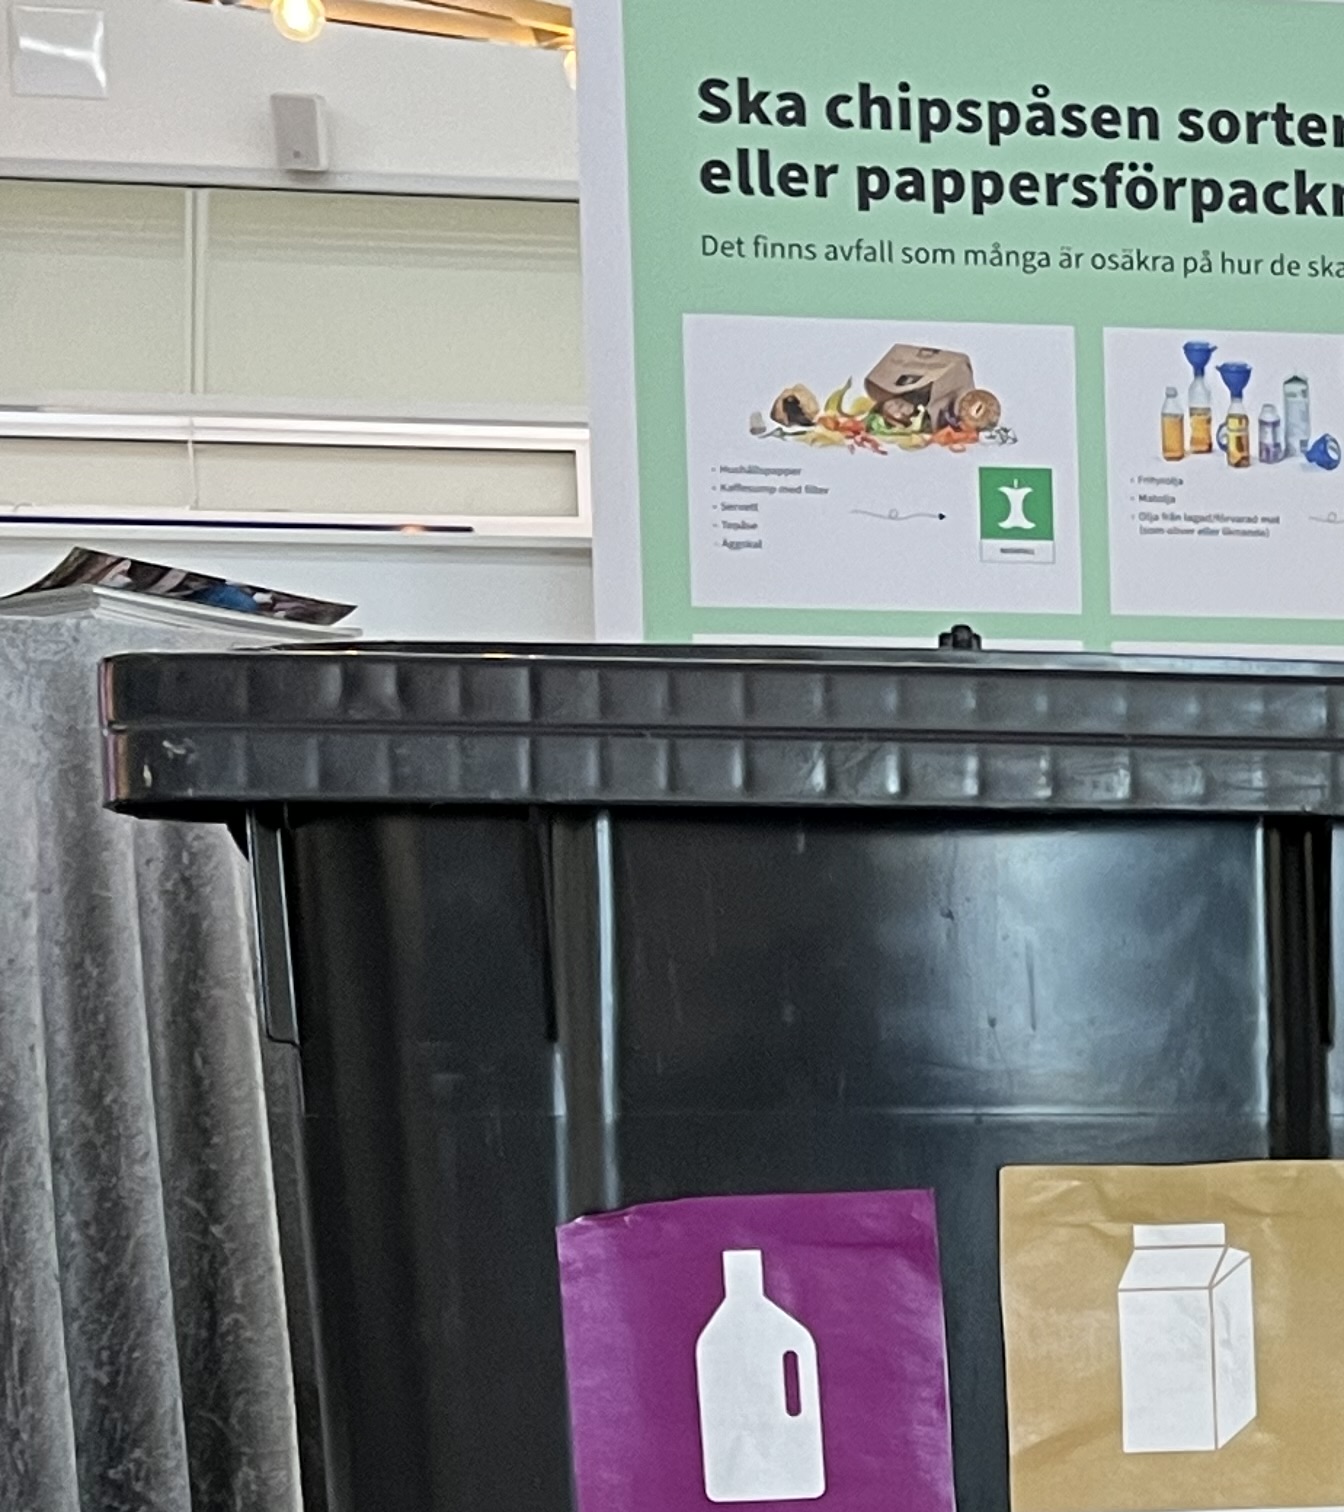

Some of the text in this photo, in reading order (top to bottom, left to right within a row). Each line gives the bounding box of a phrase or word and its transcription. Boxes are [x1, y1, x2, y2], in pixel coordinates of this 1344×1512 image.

[698, 77, 807, 127] Ska
[825, 81, 1160, 145] chipspåsen
[700, 149, 838, 198] eller
[701, 235, 746, 258] Det
[753, 235, 817, 261] finns
[824, 237, 894, 263] avfall
[901, 245, 956, 265] som
[964, 242, 1051, 274] många
[1059, 246, 1084, 269] är
[1091, 248, 1175, 272] osäkra
[1183, 250, 1214, 278] på
[1220, 252, 1264, 275] hur
[1270, 253, 1301, 276] de
